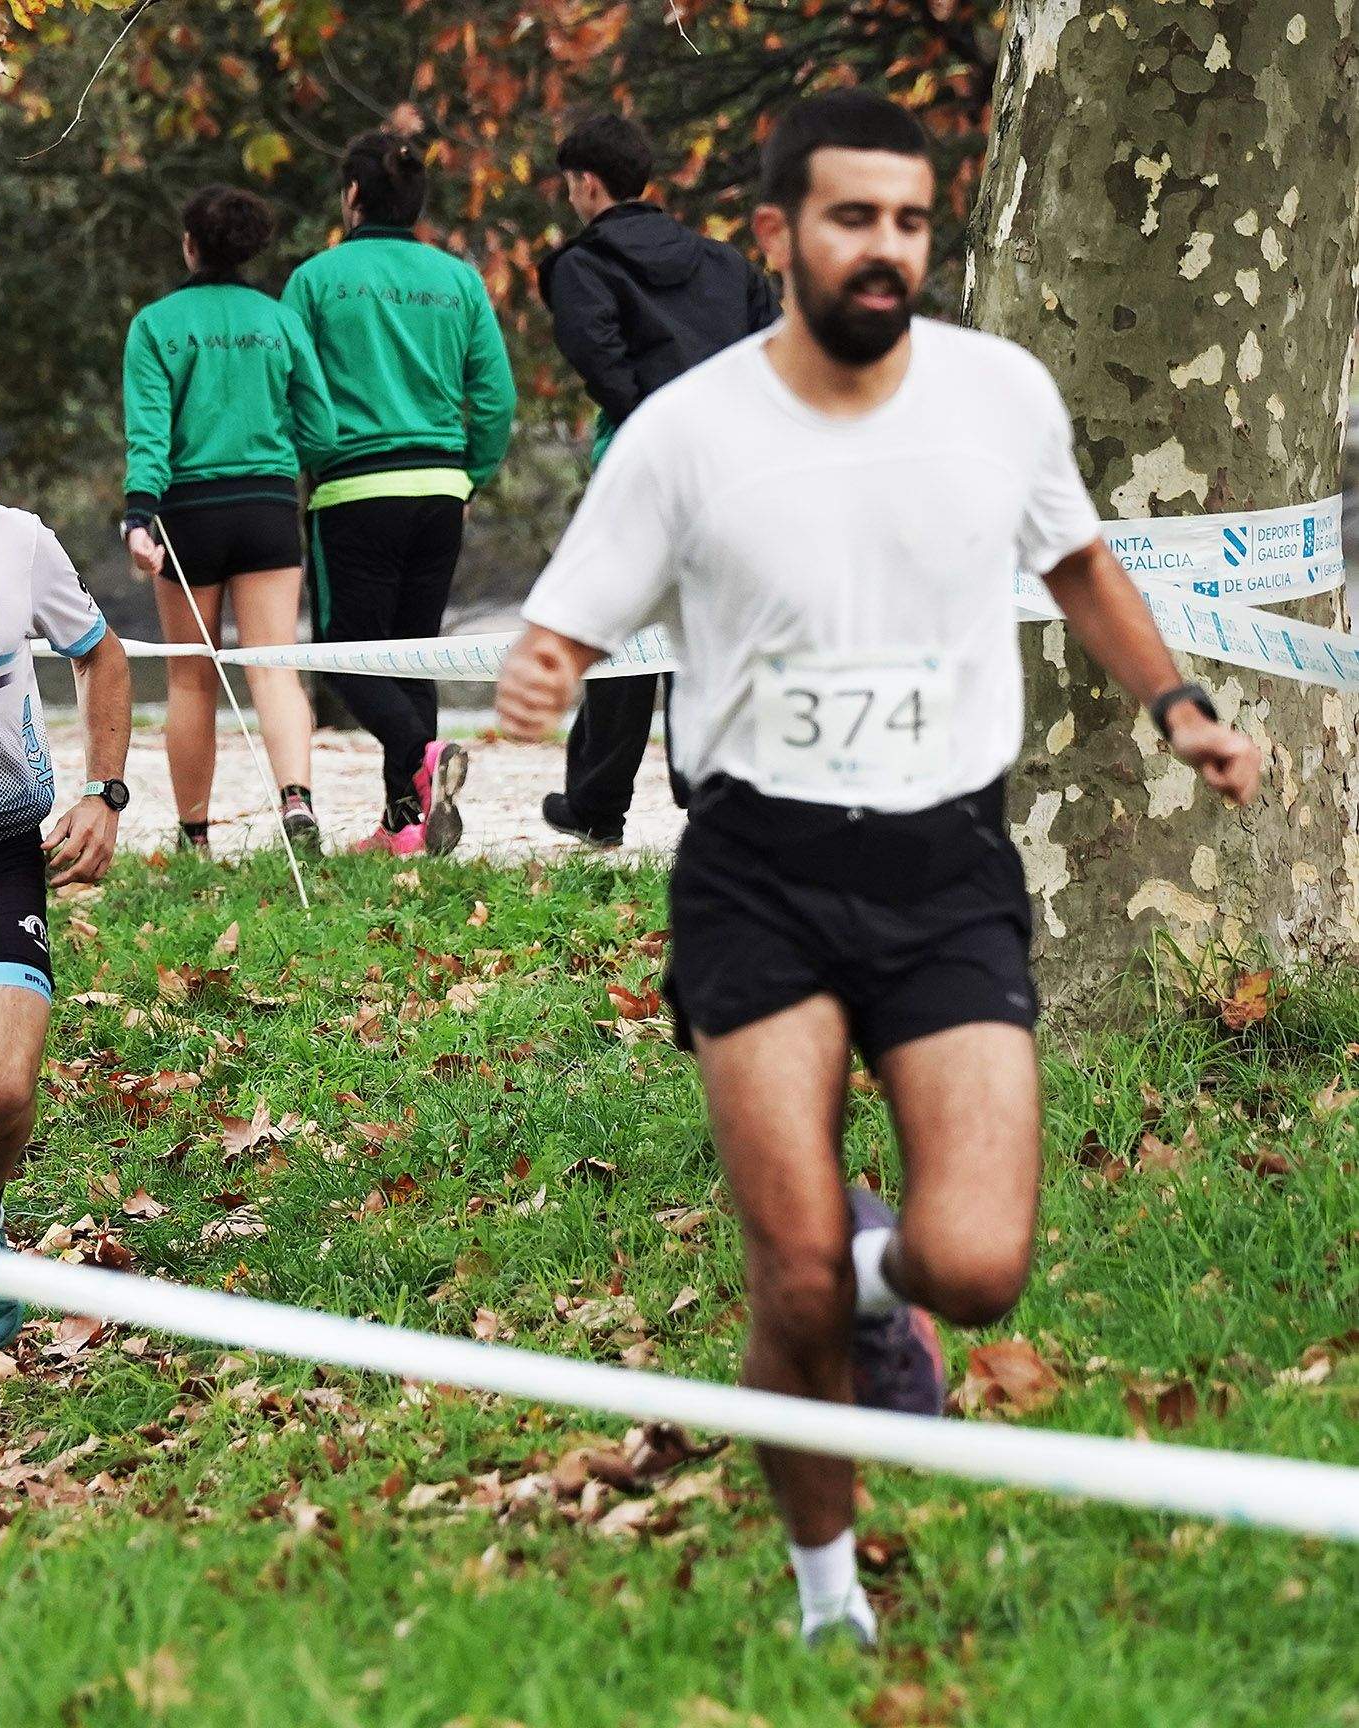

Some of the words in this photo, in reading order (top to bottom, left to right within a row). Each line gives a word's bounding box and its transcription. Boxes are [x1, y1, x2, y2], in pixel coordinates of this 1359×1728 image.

[1257, 523, 1301, 542] DEPORTE
[1120, 552, 1194, 571] GALICIA
[1257, 543, 1298, 562] GALEGO
[1224, 579, 1243, 593] DE
[1247, 572, 1292, 592] GALICIA
[782, 688, 927, 749] 374
